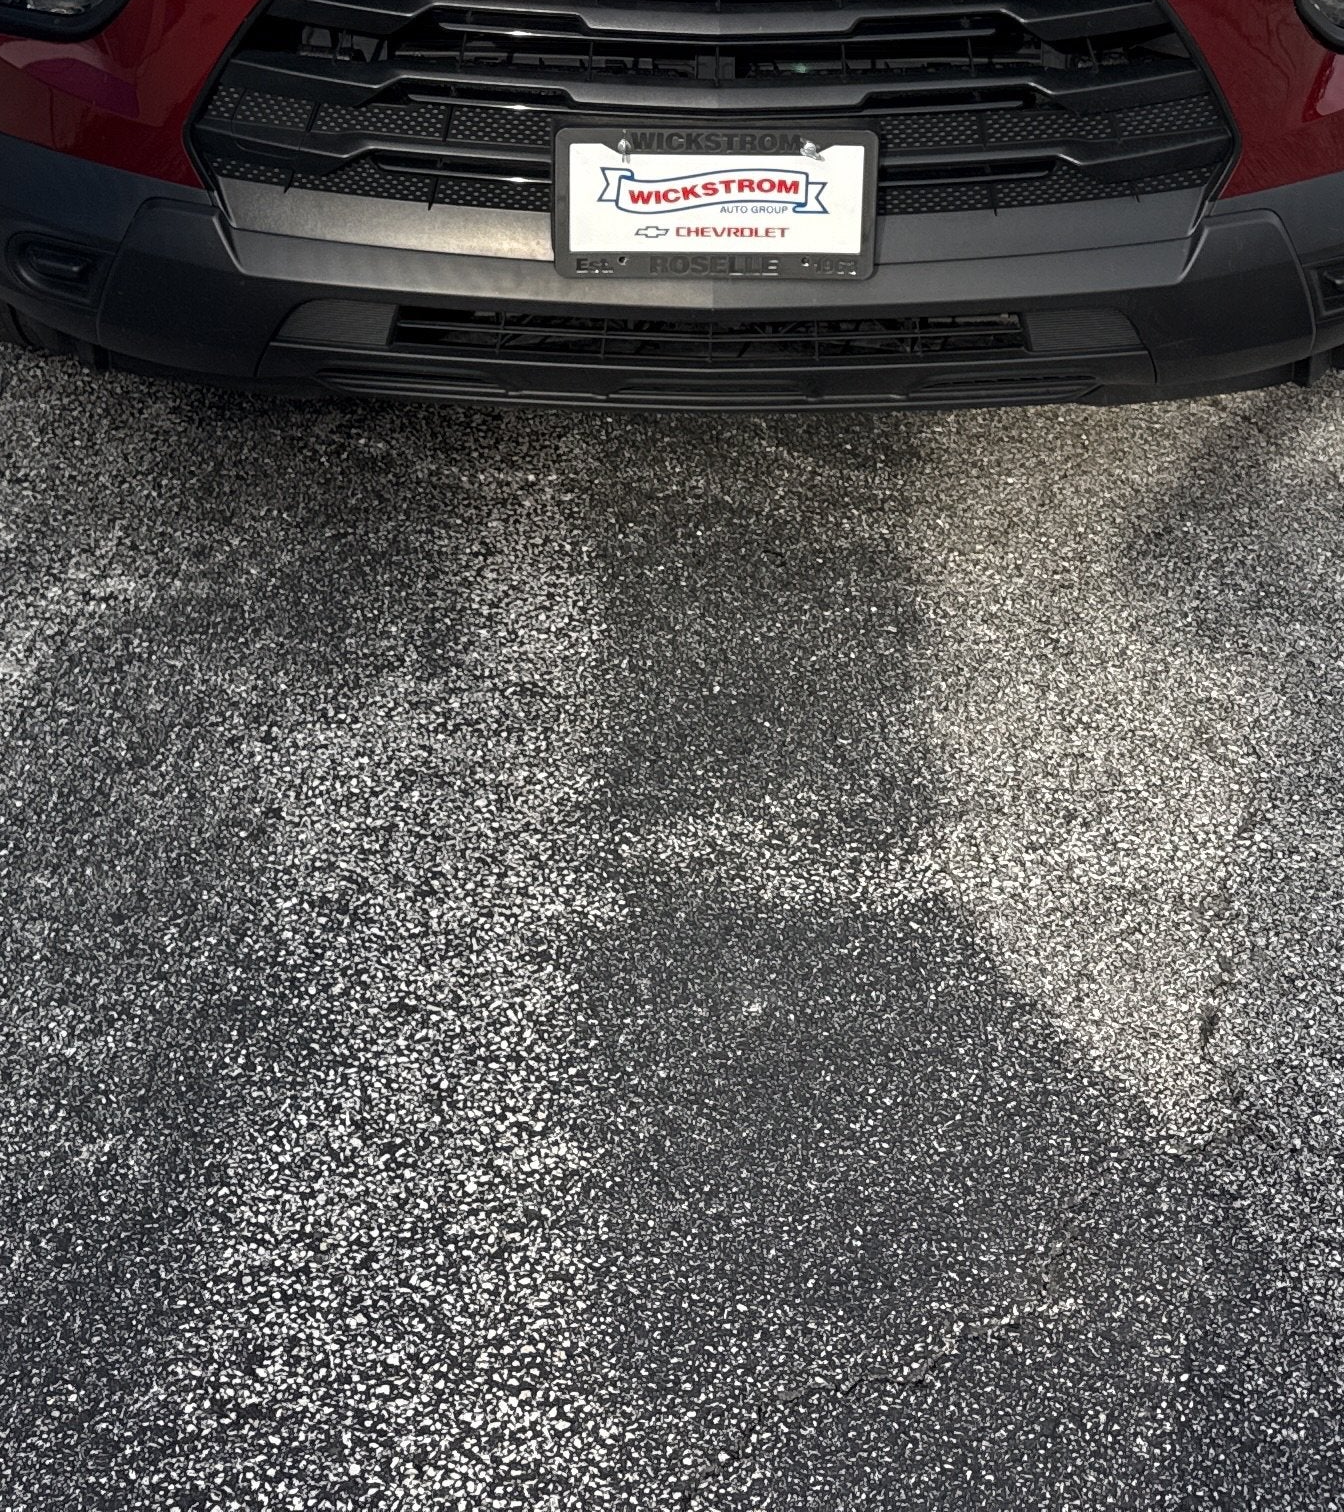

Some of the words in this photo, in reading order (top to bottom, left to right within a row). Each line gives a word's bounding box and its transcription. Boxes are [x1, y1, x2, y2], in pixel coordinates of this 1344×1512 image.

[630, 131, 801, 152] WICKSTROM
[628, 178, 800, 205] WICKSTROM
[719, 205, 748, 214] AUTO
[751, 205, 788, 214] GROUP
[675, 226, 790, 238] CHEVROLET
[649, 255, 779, 276] ROSELLE
